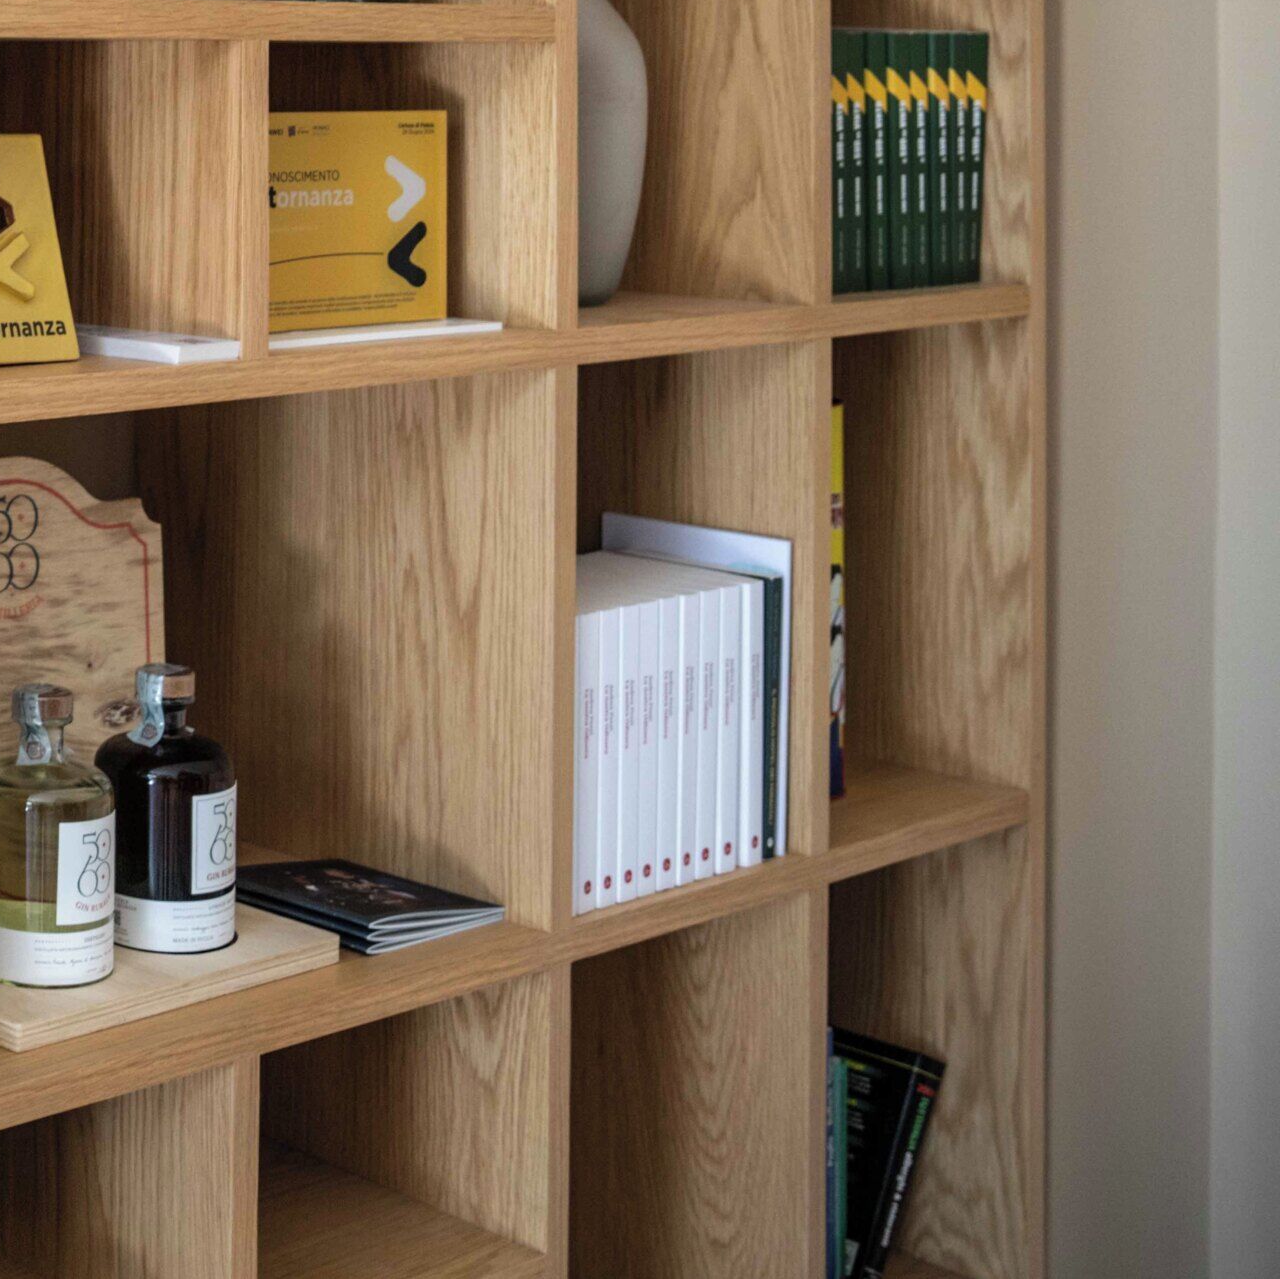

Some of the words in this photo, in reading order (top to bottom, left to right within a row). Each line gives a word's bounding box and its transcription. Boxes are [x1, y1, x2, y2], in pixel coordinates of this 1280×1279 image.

[269, 170, 339, 183] ONOSCIMENTO
[269, 186, 354, 208] tornanza
[206, 872, 219, 881] GIN
[75, 901, 90, 912] GIN
